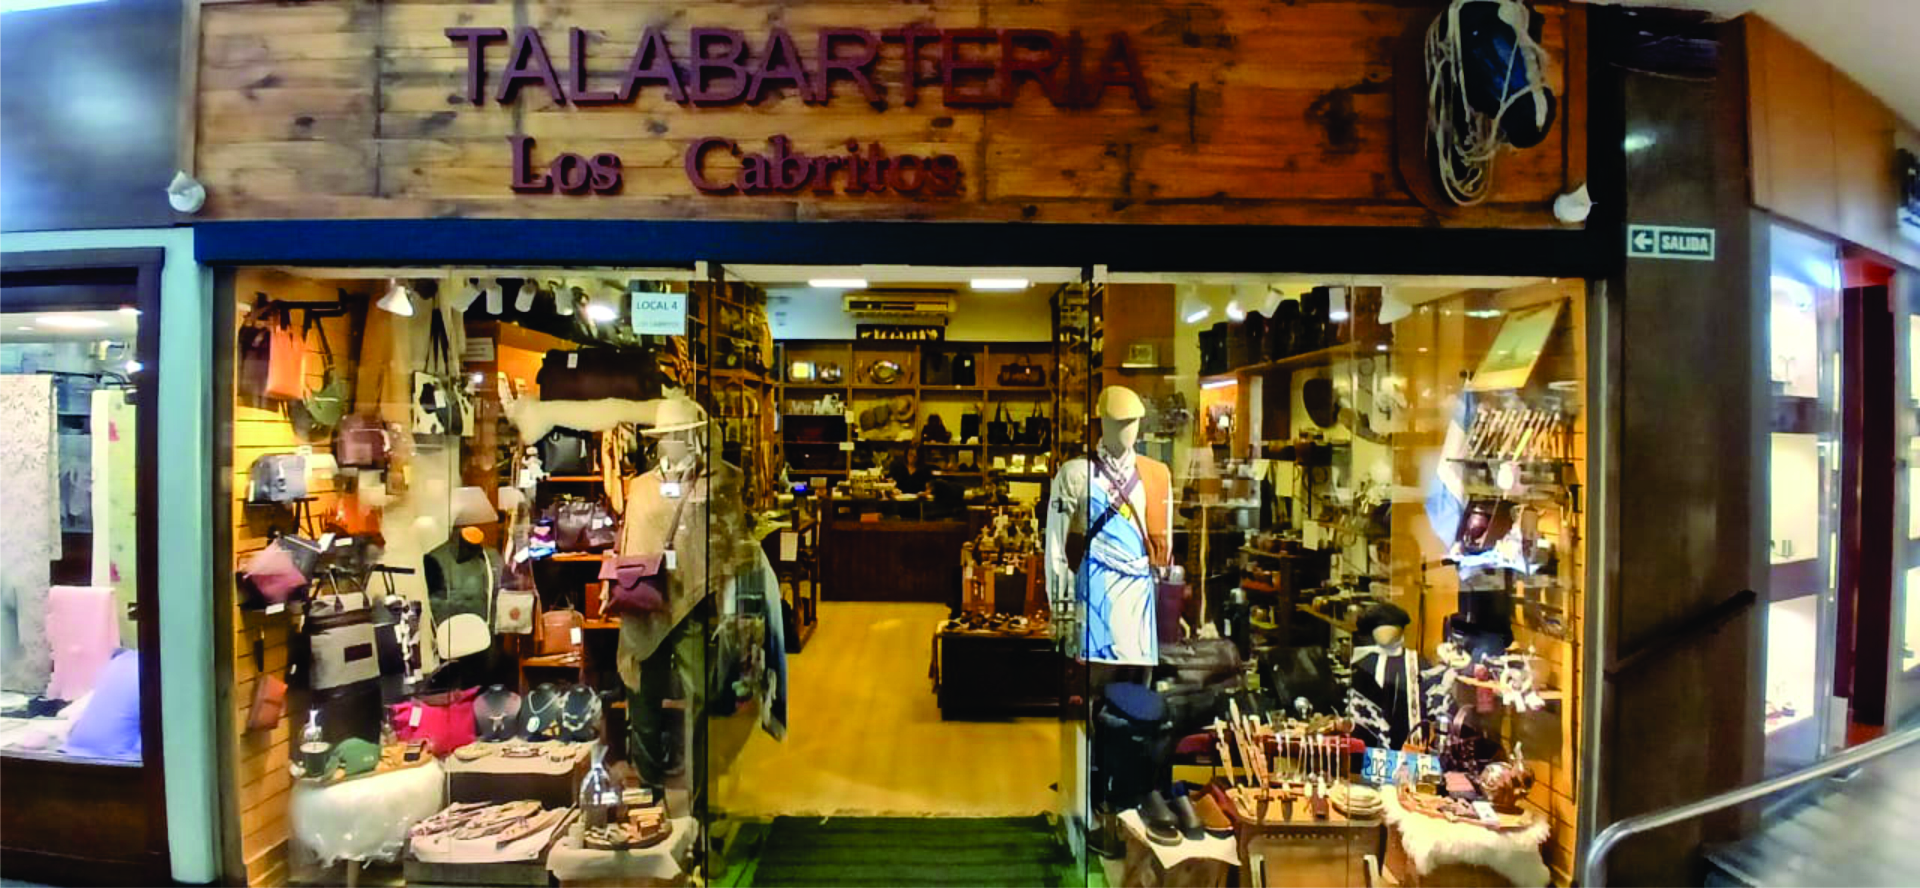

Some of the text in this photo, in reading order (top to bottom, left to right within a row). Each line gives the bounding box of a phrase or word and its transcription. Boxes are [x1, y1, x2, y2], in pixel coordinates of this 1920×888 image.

[446, 26, 1153, 110] TALABARTERIA
[508, 134, 966, 197] Los Cabritos
[1661, 234, 1708, 252] SALIDA
[636, 300, 679, 311] LOCAL 4
